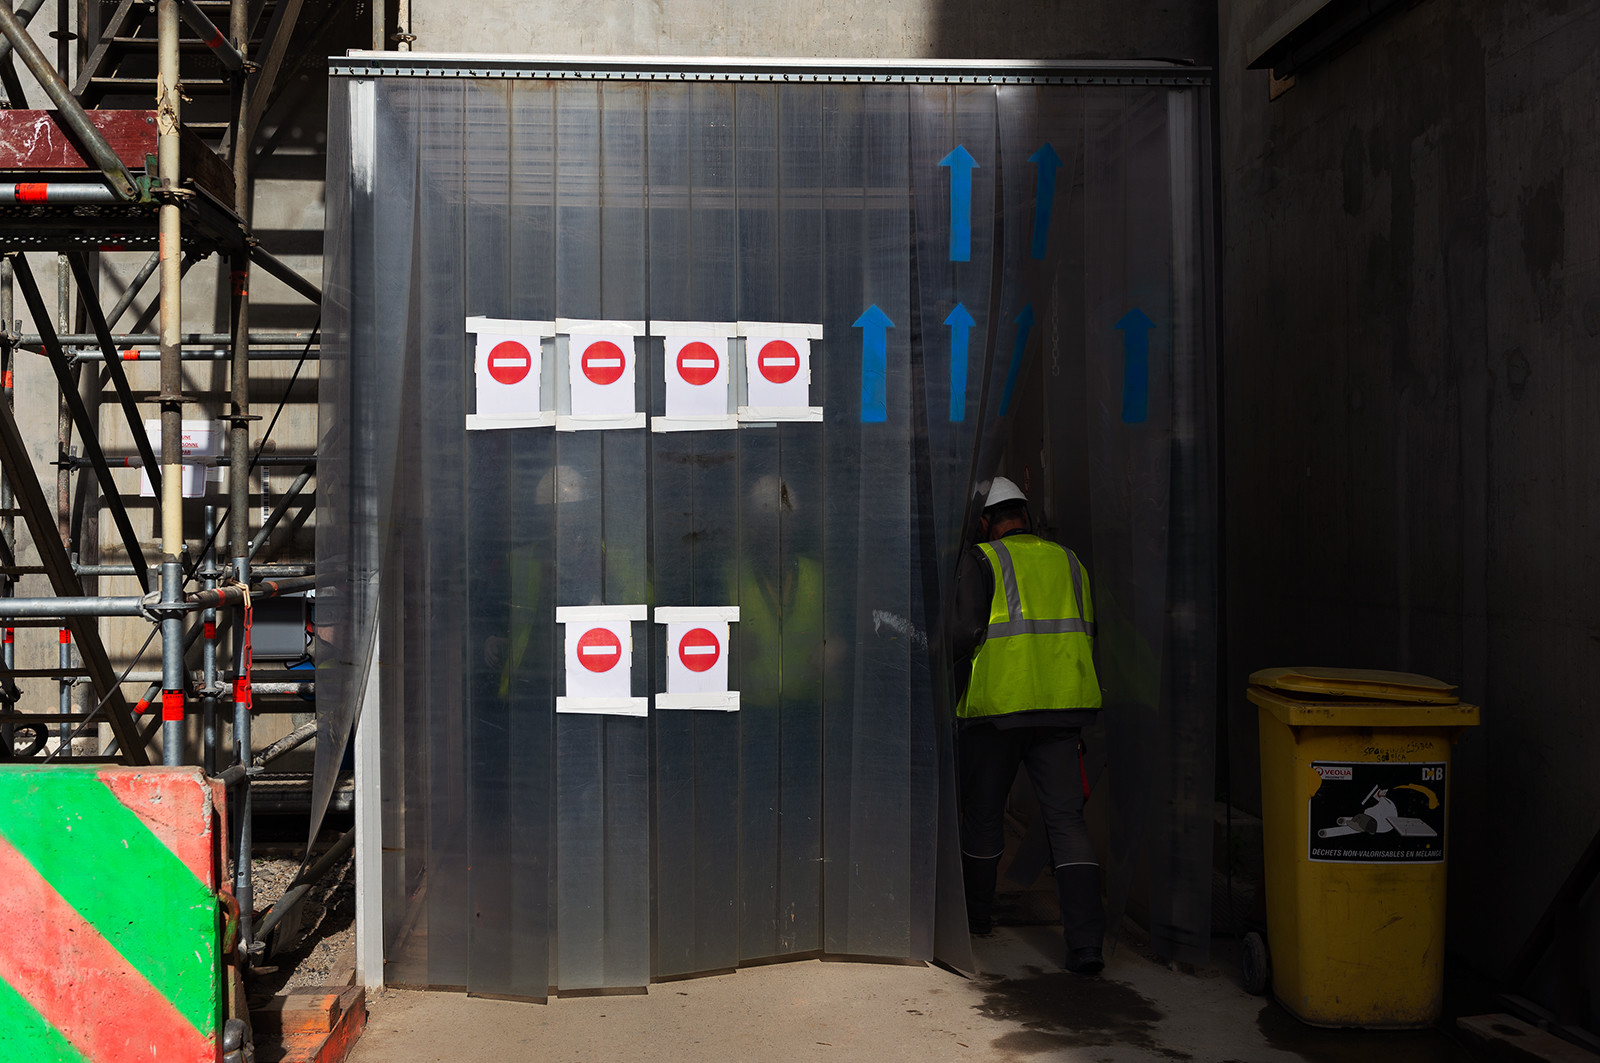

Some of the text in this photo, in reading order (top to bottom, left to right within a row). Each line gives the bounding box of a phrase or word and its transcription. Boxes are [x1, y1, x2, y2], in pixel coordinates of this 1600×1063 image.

[1421, 767, 1444, 781] DIB
[1342, 849, 1405, 858] NON-VALORISABLES
[1405, 850, 1415, 858] EN
